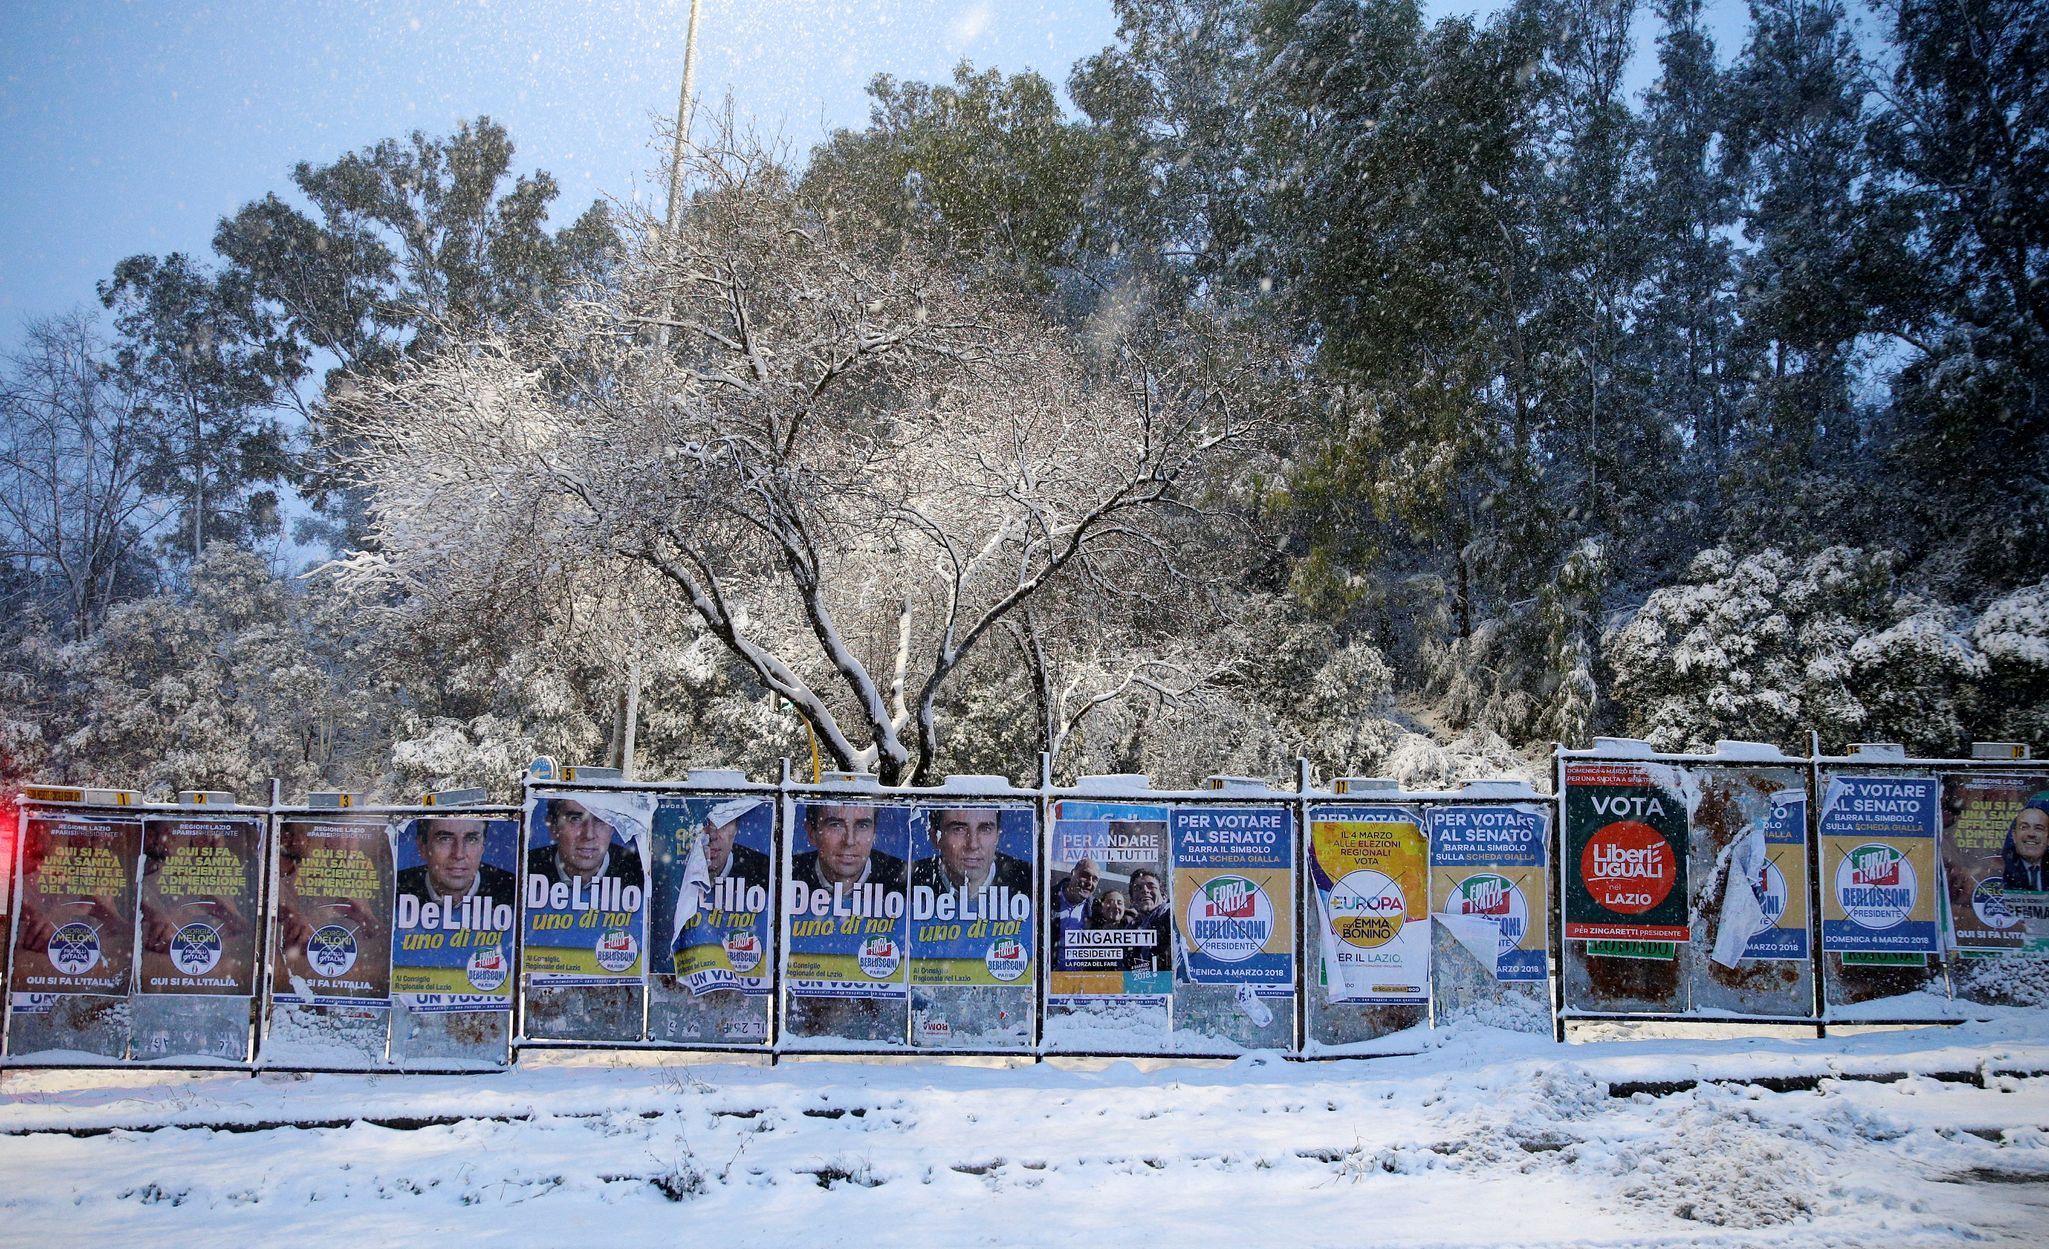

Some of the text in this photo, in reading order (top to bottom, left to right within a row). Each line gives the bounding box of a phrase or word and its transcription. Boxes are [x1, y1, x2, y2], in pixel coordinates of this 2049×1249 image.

[566, 768, 571, 780] 5
[1336, 781, 1345, 794] 11
[1860, 785, 1926, 797] VOTARE
[344, 795, 349, 808] 3
[1591, 795, 1665, 817] VOTA
[1832, 799, 1920, 813] AL SENATO
[1971, 800, 2006, 810] QUI SI
[1178, 815, 1281, 828] PER VOTARE
[1434, 813, 1535, 829] PER VOTARE
[1063, 834, 1159, 847] PER ANDARE
[1183, 831, 1276, 844] AL SENATO
[1440, 829, 1532, 842] AL SENATO
[1358, 840, 1401, 848] ELEZIONI
[1957, 839, 1979, 848] DEL
[55, 847, 111, 858] QUI SI FA
[176, 847, 231, 857] QUI SI FA
[1066, 850, 1157, 861] AVANTI, TUTTI.
[1340, 849, 1391, 857] REGIONALI
[44, 855, 121, 867] UNA SANITÀ
[166, 854, 240, 866] UNA SANITÀ
[1179, 855, 1280, 863] SULLA SCHEDA GIALLA
[1859, 849, 1891, 869] FORZA
[41, 865, 124, 878] EFFICIENTE E
[162, 866, 243, 876] EFFICIENTE E
[1594, 862, 1662, 878] UGUALI
[37, 875, 127, 887] A DIMENSIONE
[157, 876, 247, 886] A DIMENSIONE
[40, 885, 122, 897] DEL MALATO.
[161, 886, 242, 896] DEL MALATO.
[1213, 880, 1246, 900] FORZA
[1470, 878, 1502, 898] FORZA
[1213, 892, 1248, 915] ITALIA
[1605, 893, 1652, 905] LAZIO
[1843, 888, 1910, 907] BERLUSCONI
[532, 908, 633, 930] uno di noi
[708, 908, 759, 928] di noi
[1854, 910, 1901, 918] PRESIDENTE
[792, 914, 896, 937] uno di noi
[918, 917, 1023, 942] uno di noi
[1195, 920, 1266, 940] BERLUSCONI
[1355, 919, 1390, 929] EMMA
[177, 934, 217, 943] MELONI
[402, 927, 504, 950] uno di noi
[1067, 932, 1155, 944] ZINGARETTI
[1343, 929, 1391, 939] BONINO
[1956, 930, 1976, 938] QUI
[1987, 931, 2001, 939] FA
[314, 936, 352, 945] MELONI
[1066, 950, 1121, 958] PRESIDENTE
[1356, 953, 1365, 962] IL
[860, 957, 897, 968] BERLUSCONI
[988, 960, 1025, 970] BERLUSCONI
[26, 976, 73, 986] QUI SI FA
[150, 977, 168, 986] QUI
[170, 978, 180, 986] SI
[182, 978, 195, 986] FA
[306, 979, 316, 987] SI
[318, 979, 330, 988] FA
[690, 972, 707, 987] UN
